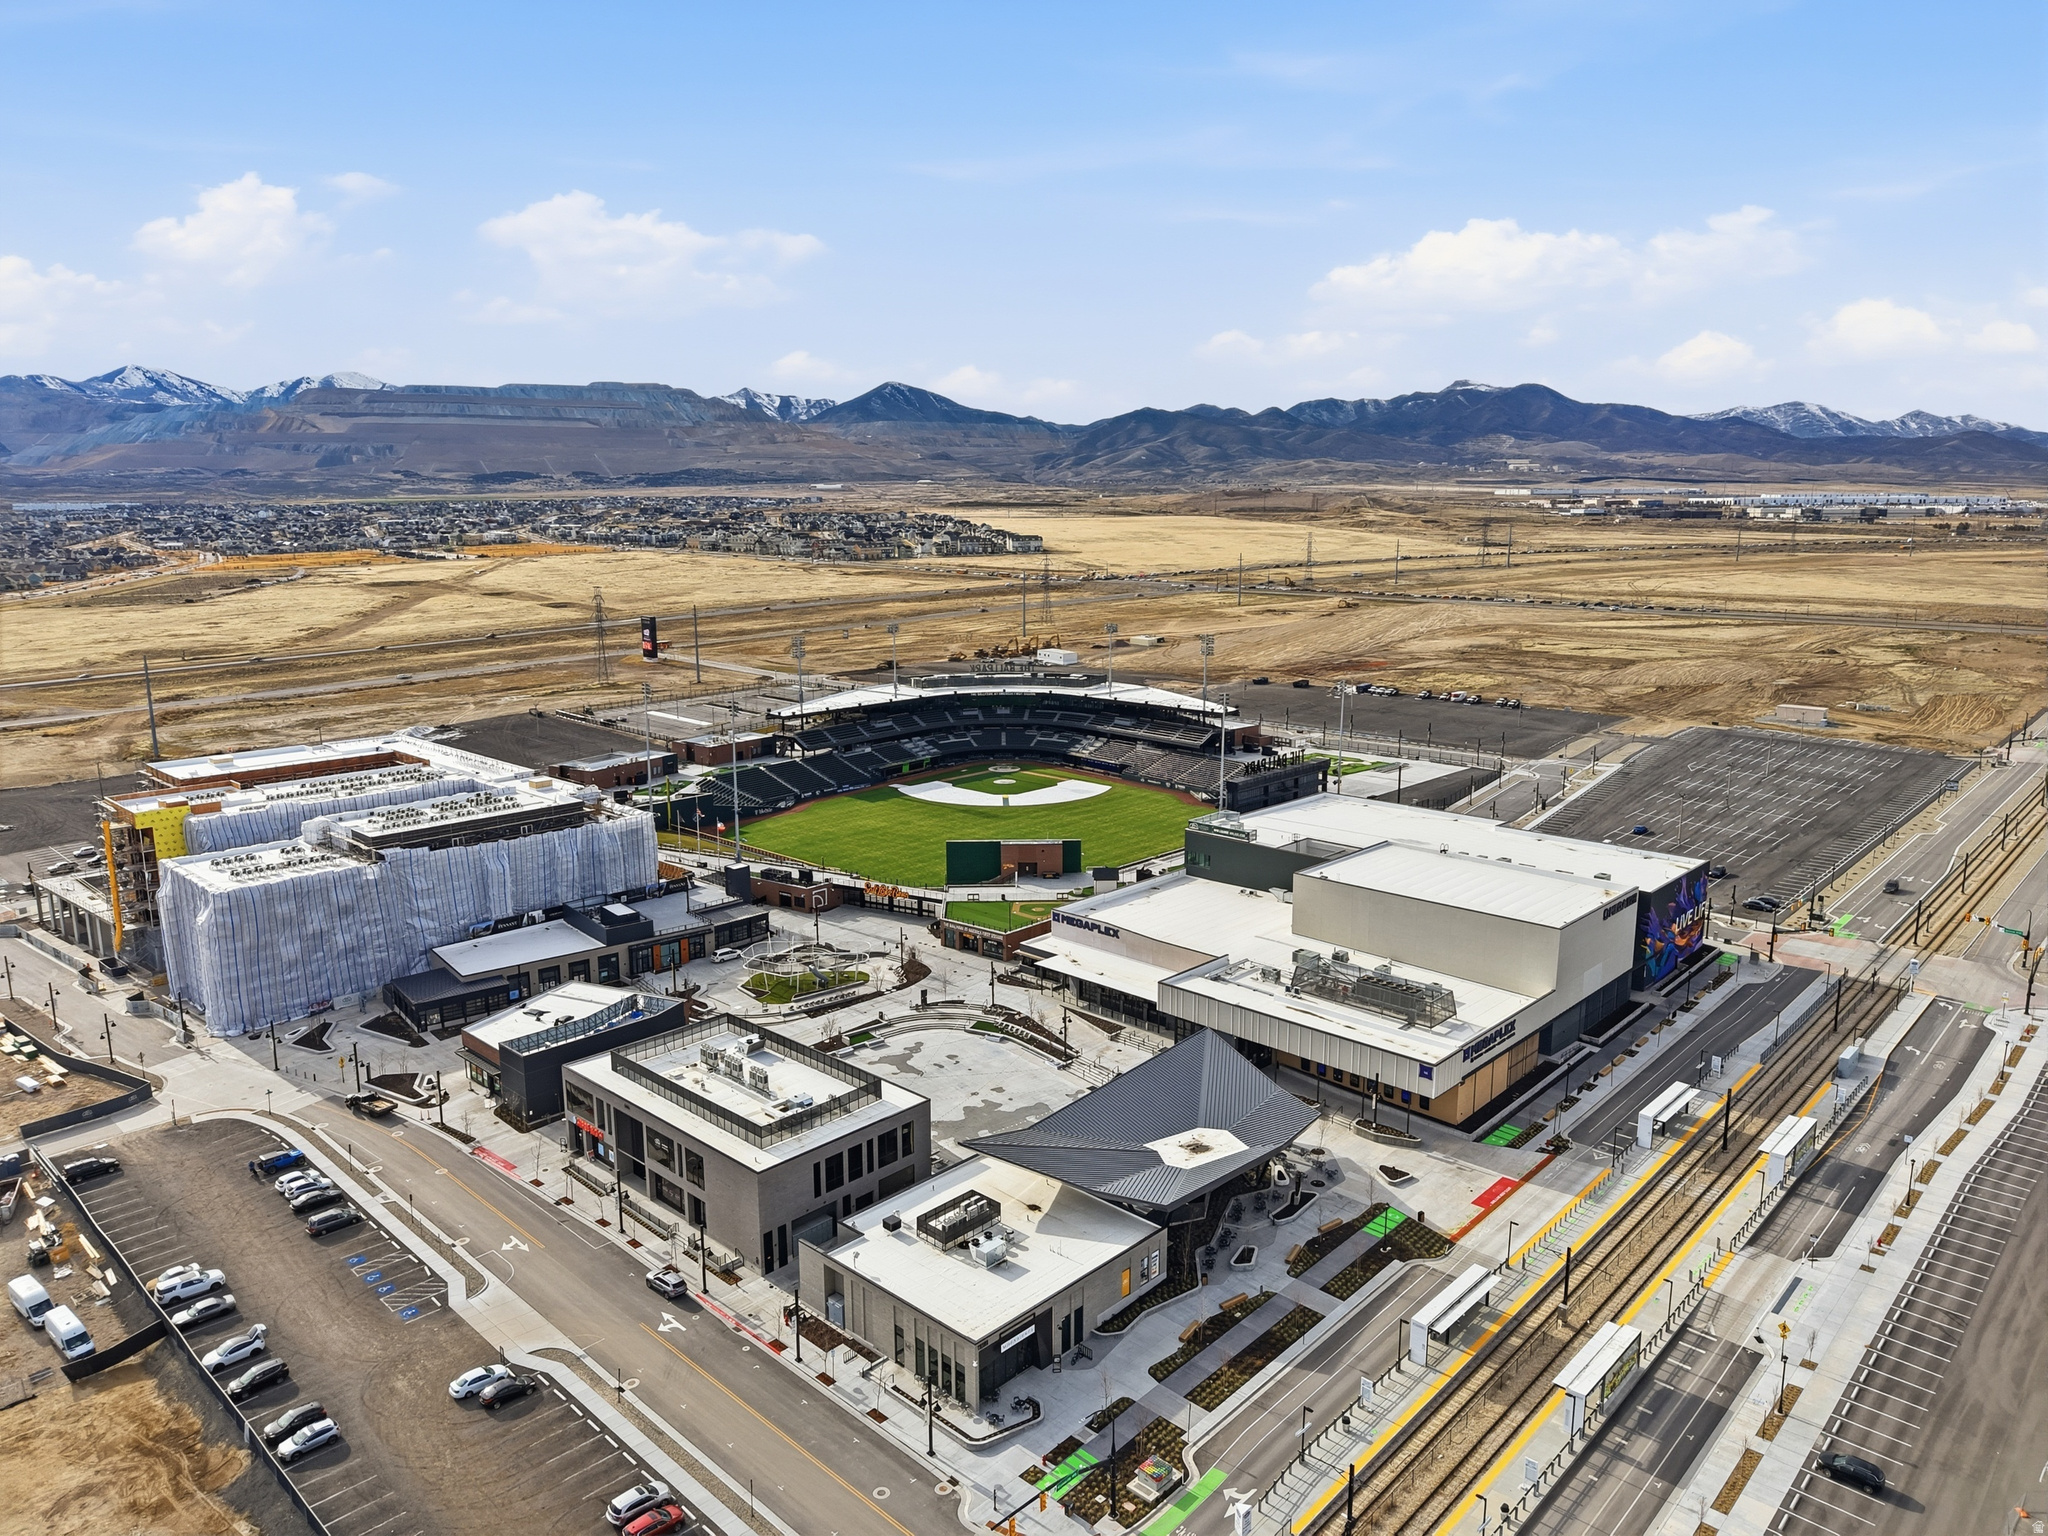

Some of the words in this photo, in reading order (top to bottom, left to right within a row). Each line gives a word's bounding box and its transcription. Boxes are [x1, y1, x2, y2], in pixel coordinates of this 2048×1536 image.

[1062, 914, 1120, 939] MEGAPLEX
[1675, 908, 1694, 932] LIVE
[1471, 1018, 1516, 1058] MEGAPLEX
